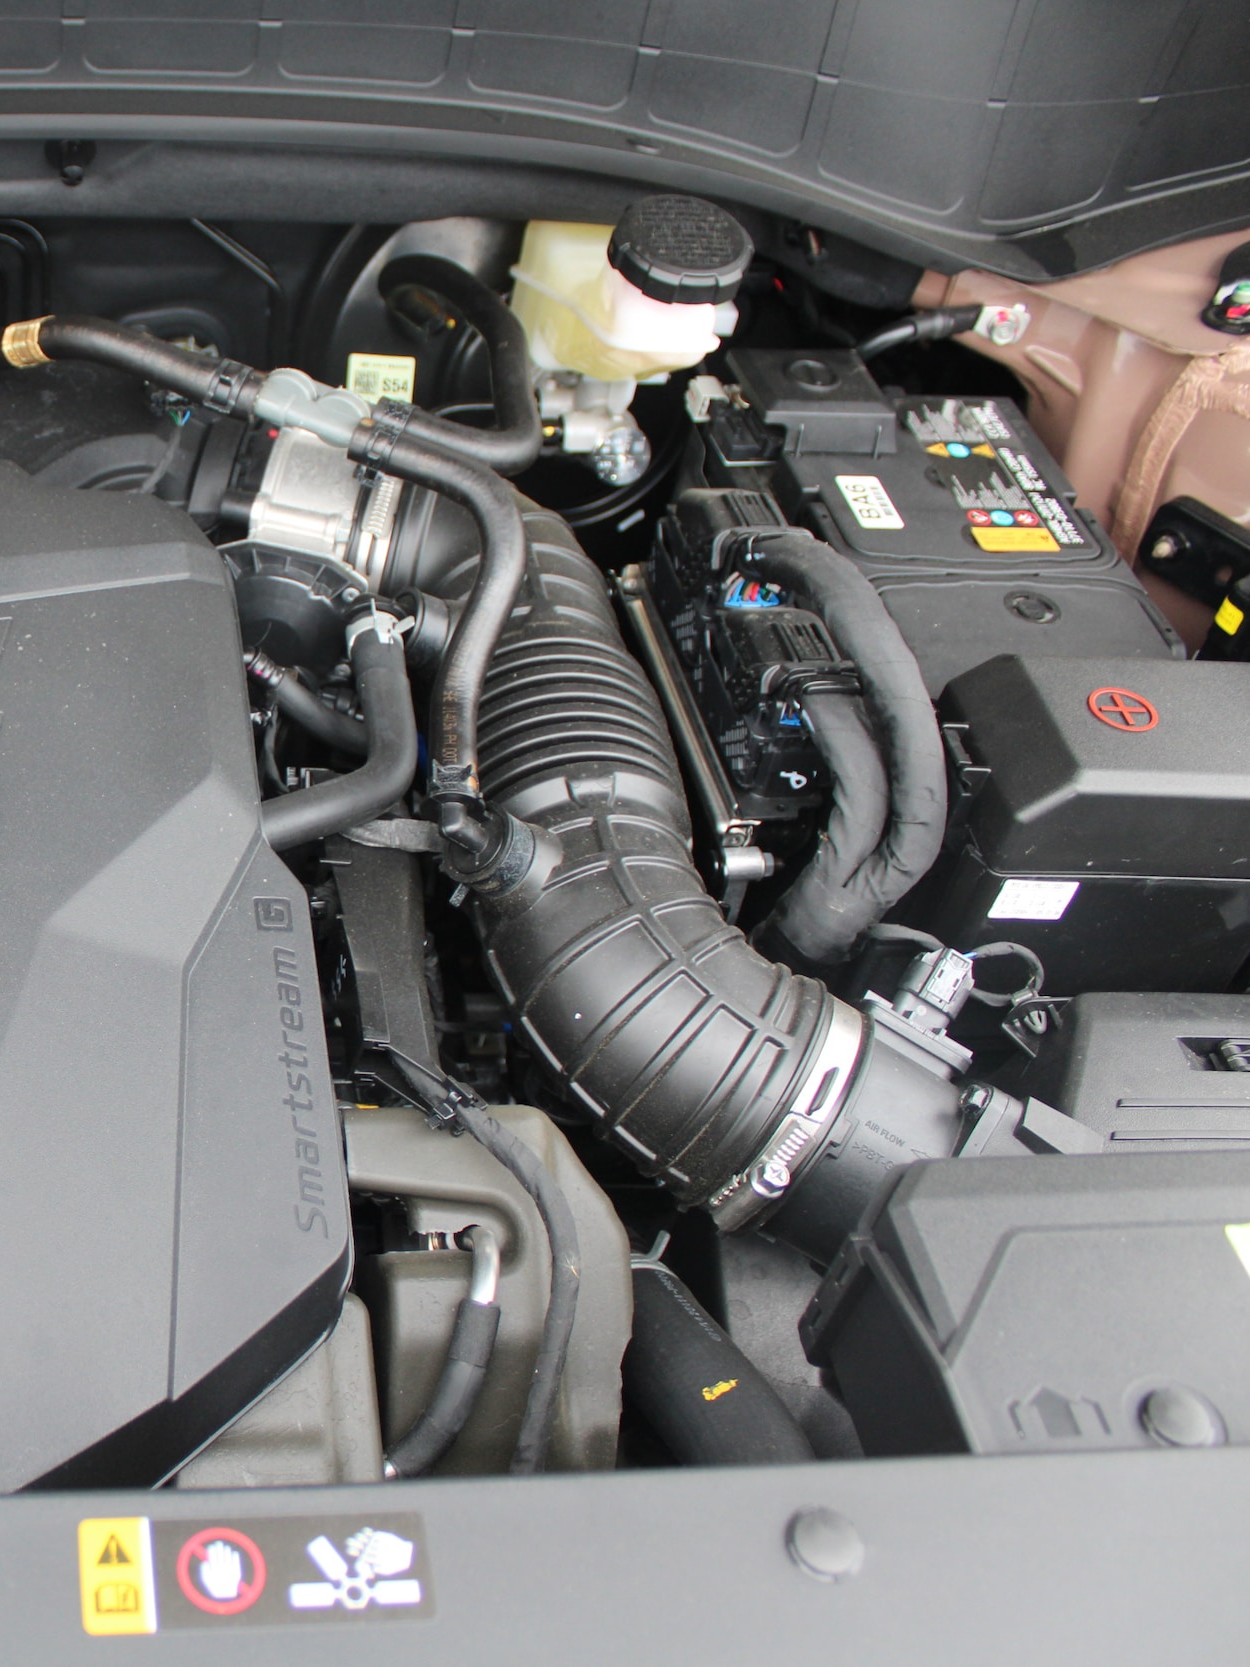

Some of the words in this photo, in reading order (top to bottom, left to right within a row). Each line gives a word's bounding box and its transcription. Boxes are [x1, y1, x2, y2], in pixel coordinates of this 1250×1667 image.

[382, 378, 408, 393] S54
[845, 484, 881, 519] BA6
[272, 946, 329, 1240] Smartstream
[864, 1120, 880, 1134] AIR
[880, 1128, 905, 1147] FLOW
